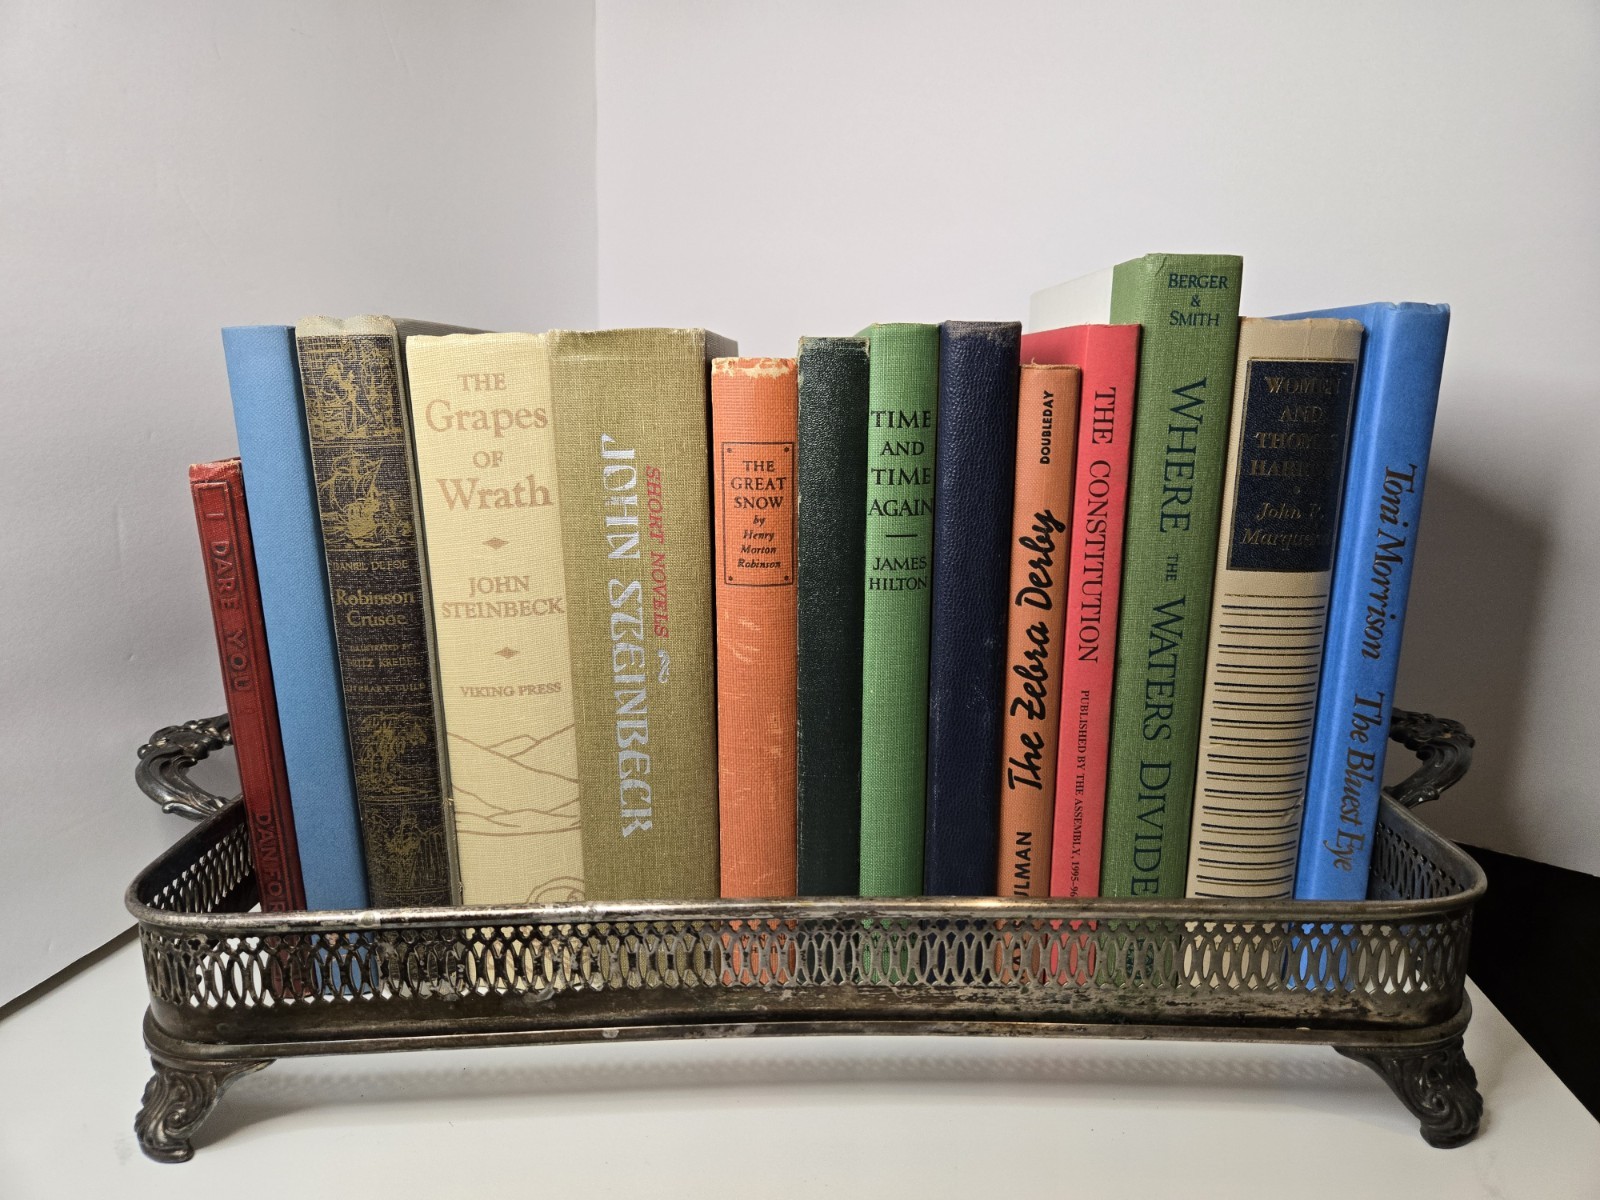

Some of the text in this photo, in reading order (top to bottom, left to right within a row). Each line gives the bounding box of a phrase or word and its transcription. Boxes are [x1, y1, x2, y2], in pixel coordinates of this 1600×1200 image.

[1168, 273, 1228, 289] BERGER
[1190, 295, 1201, 308] &
[1169, 310, 1219, 327] SMITH
[457, 372, 507, 392] THE
[425, 399, 549, 438] Grapes
[870, 410, 931, 429] TIME
[1092, 387, 1117, 444] THE
[1278, 405, 1324, 423] AND
[1039, 389, 1055, 465] DOUBLEDAY
[881, 441, 925, 456] AND
[472, 450, 503, 469] OF
[742, 460, 776, 473] THE
[730, 476, 787, 491] GREAT
[870, 468, 931, 486] TIME
[436, 474, 554, 511] Wrath
[734, 496, 783, 510] SNOW
[868, 499, 932, 517] AGAIN
[1255, 501, 1303, 521] John
[753, 514, 766, 527] by
[743, 529, 775, 542] Henry
[645, 464, 670, 639] SHORT NOVELS
[740, 544, 777, 555] Morton
[737, 558, 781, 569] Robinson
[872, 556, 928, 571] JAMES
[1078, 460, 1112, 664] CONSTITUTION
[469, 575, 531, 598] JOHN
[868, 576, 928, 592] HILTON
[335, 588, 416, 606] Robinson
[210, 540, 240, 610] DARE
[226, 629, 252, 692] YOU
[441, 597, 565, 619] STEINBECK
[346, 610, 409, 628] Crusoe
[601, 433, 653, 838] JOHN STEINBECK
[1131, 377, 1207, 896] WHERE THE WATERS DIVIDE
[1007, 509, 1066, 790] The Zebra Derby
[1323, 463, 1418, 873] Toni Morrison The Bluest Eye
[460, 682, 562, 698] VIKING PRESS
[1076, 690, 1090, 753] PUBLISHED
[1076, 756, 1087, 771] BY
[1074, 773, 1086, 796] THE
[1070, 798, 1084, 860] ASSEMBLY,
